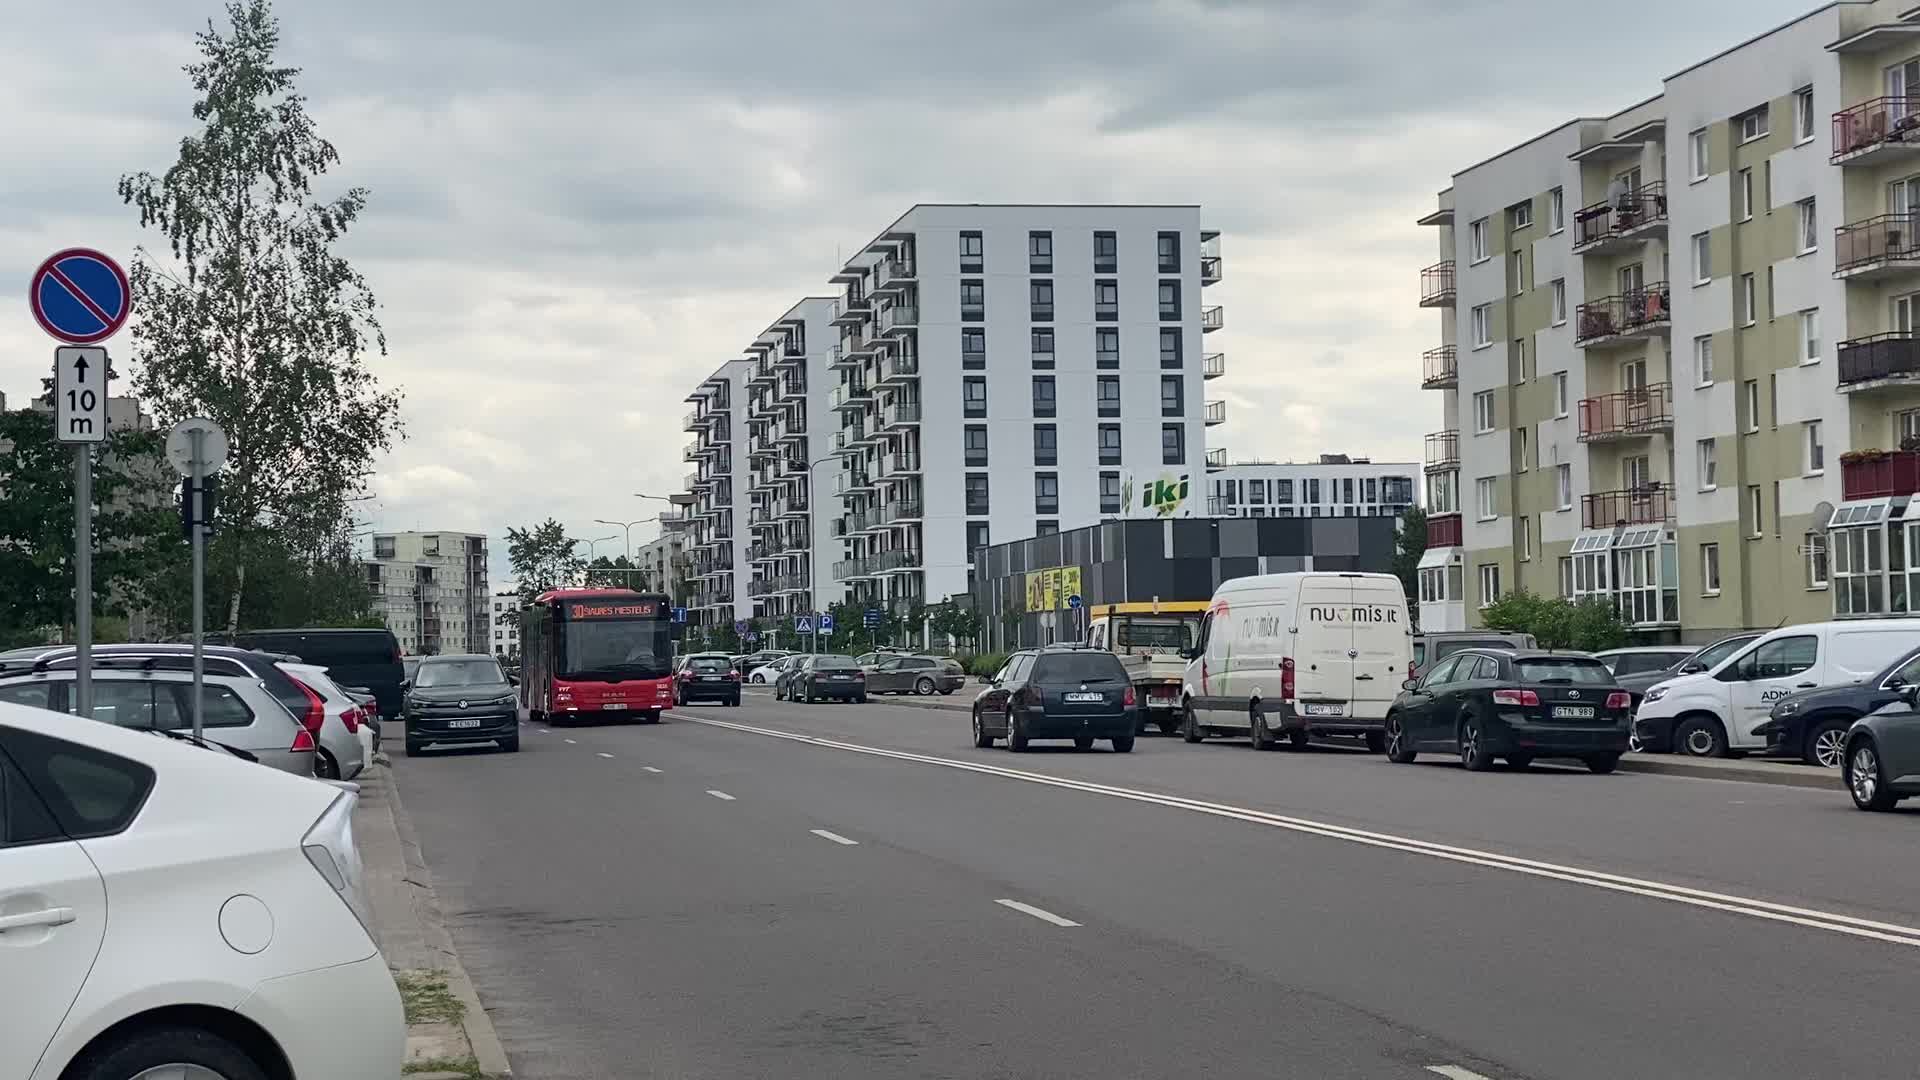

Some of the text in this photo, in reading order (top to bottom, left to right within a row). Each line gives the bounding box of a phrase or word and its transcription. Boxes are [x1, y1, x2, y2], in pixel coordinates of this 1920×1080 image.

[67, 390, 96, 412] 10
[70, 418, 93, 434] m
[1143, 474, 1189, 508] iki
[572, 604, 584, 618] 30
[822, 617, 830, 627] P
[1761, 690, 1792, 700] ADM
[1556, 707, 1593, 716] GTN 989
